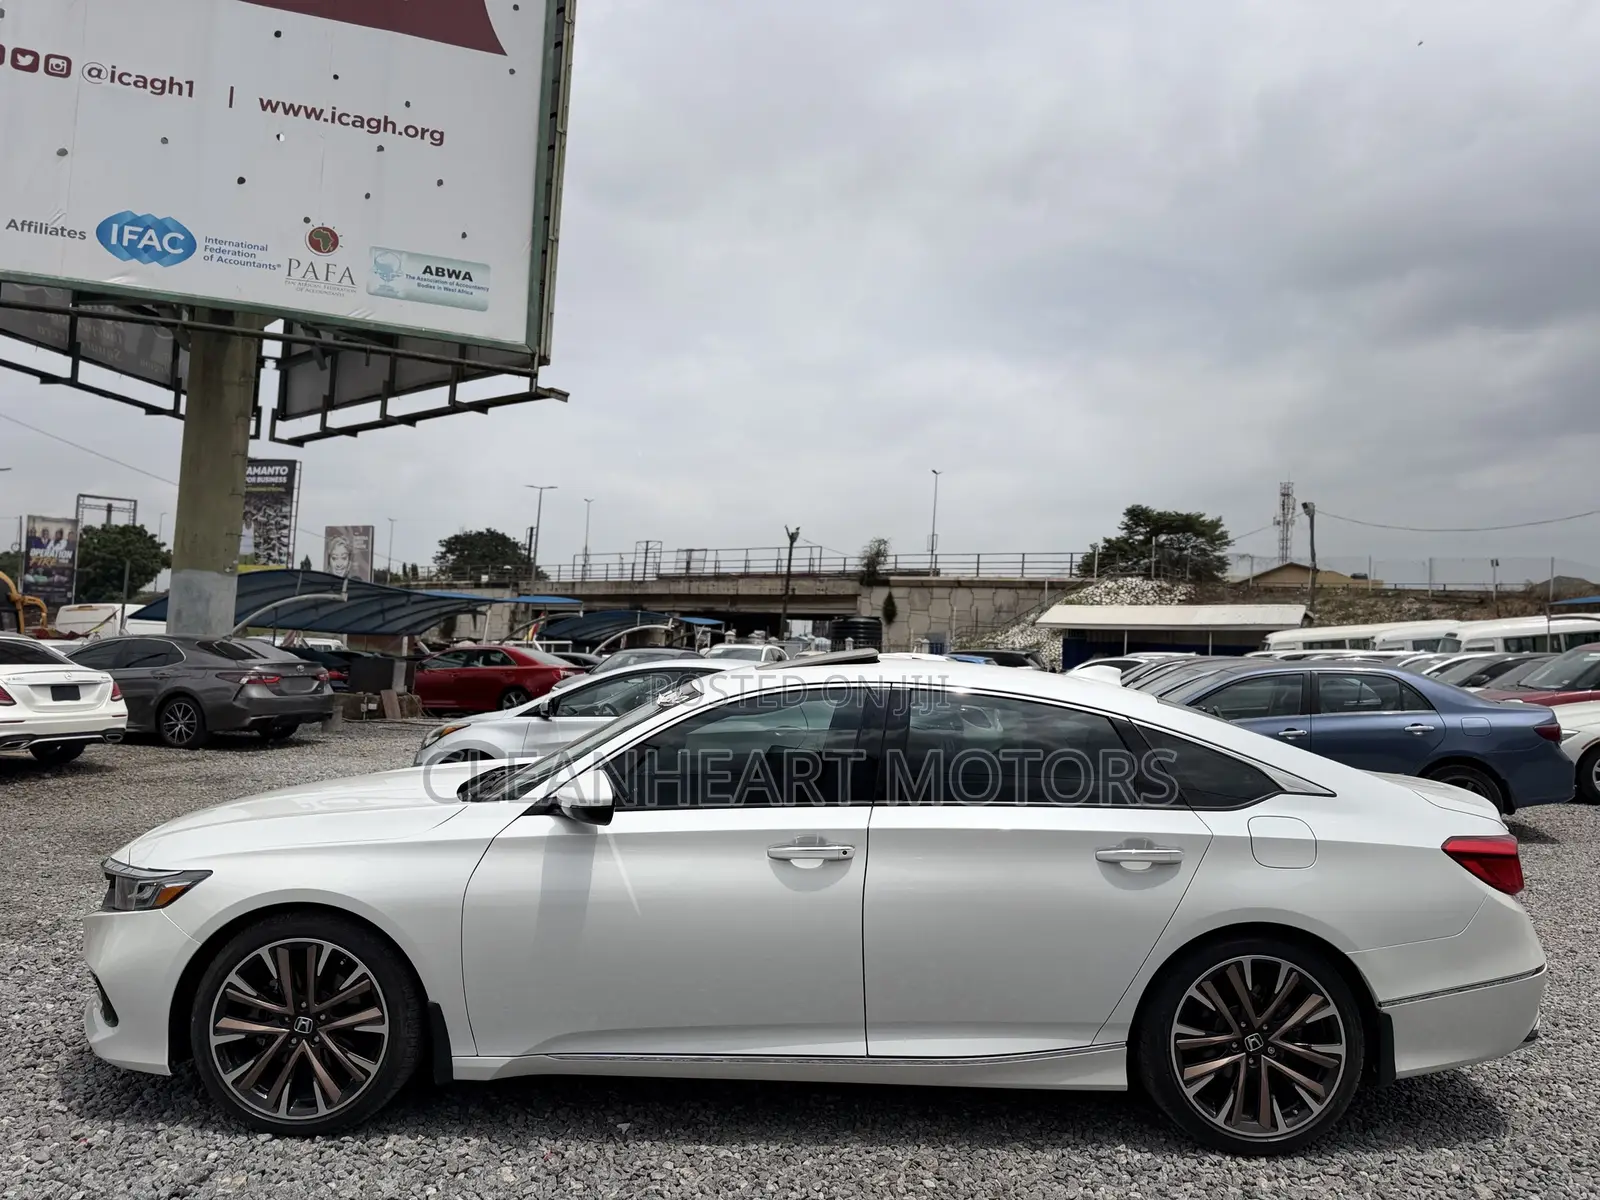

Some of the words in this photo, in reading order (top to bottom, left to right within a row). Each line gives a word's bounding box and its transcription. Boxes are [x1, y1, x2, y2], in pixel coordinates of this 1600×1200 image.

[82, 61, 194, 98] @icagh1
[258, 97, 445, 146] www.icagh.org
[5, 218, 87, 240] Affiliates
[110, 223, 185, 254] IFAC
[204, 236, 268, 251] International
[203, 254, 214, 262] of
[204, 245, 256, 259] Federation
[287, 258, 356, 285] PAFA
[422, 265, 473, 282] ABWA
[416, 276, 448, 285] Association
[246, 465, 289, 475] AMANTO
